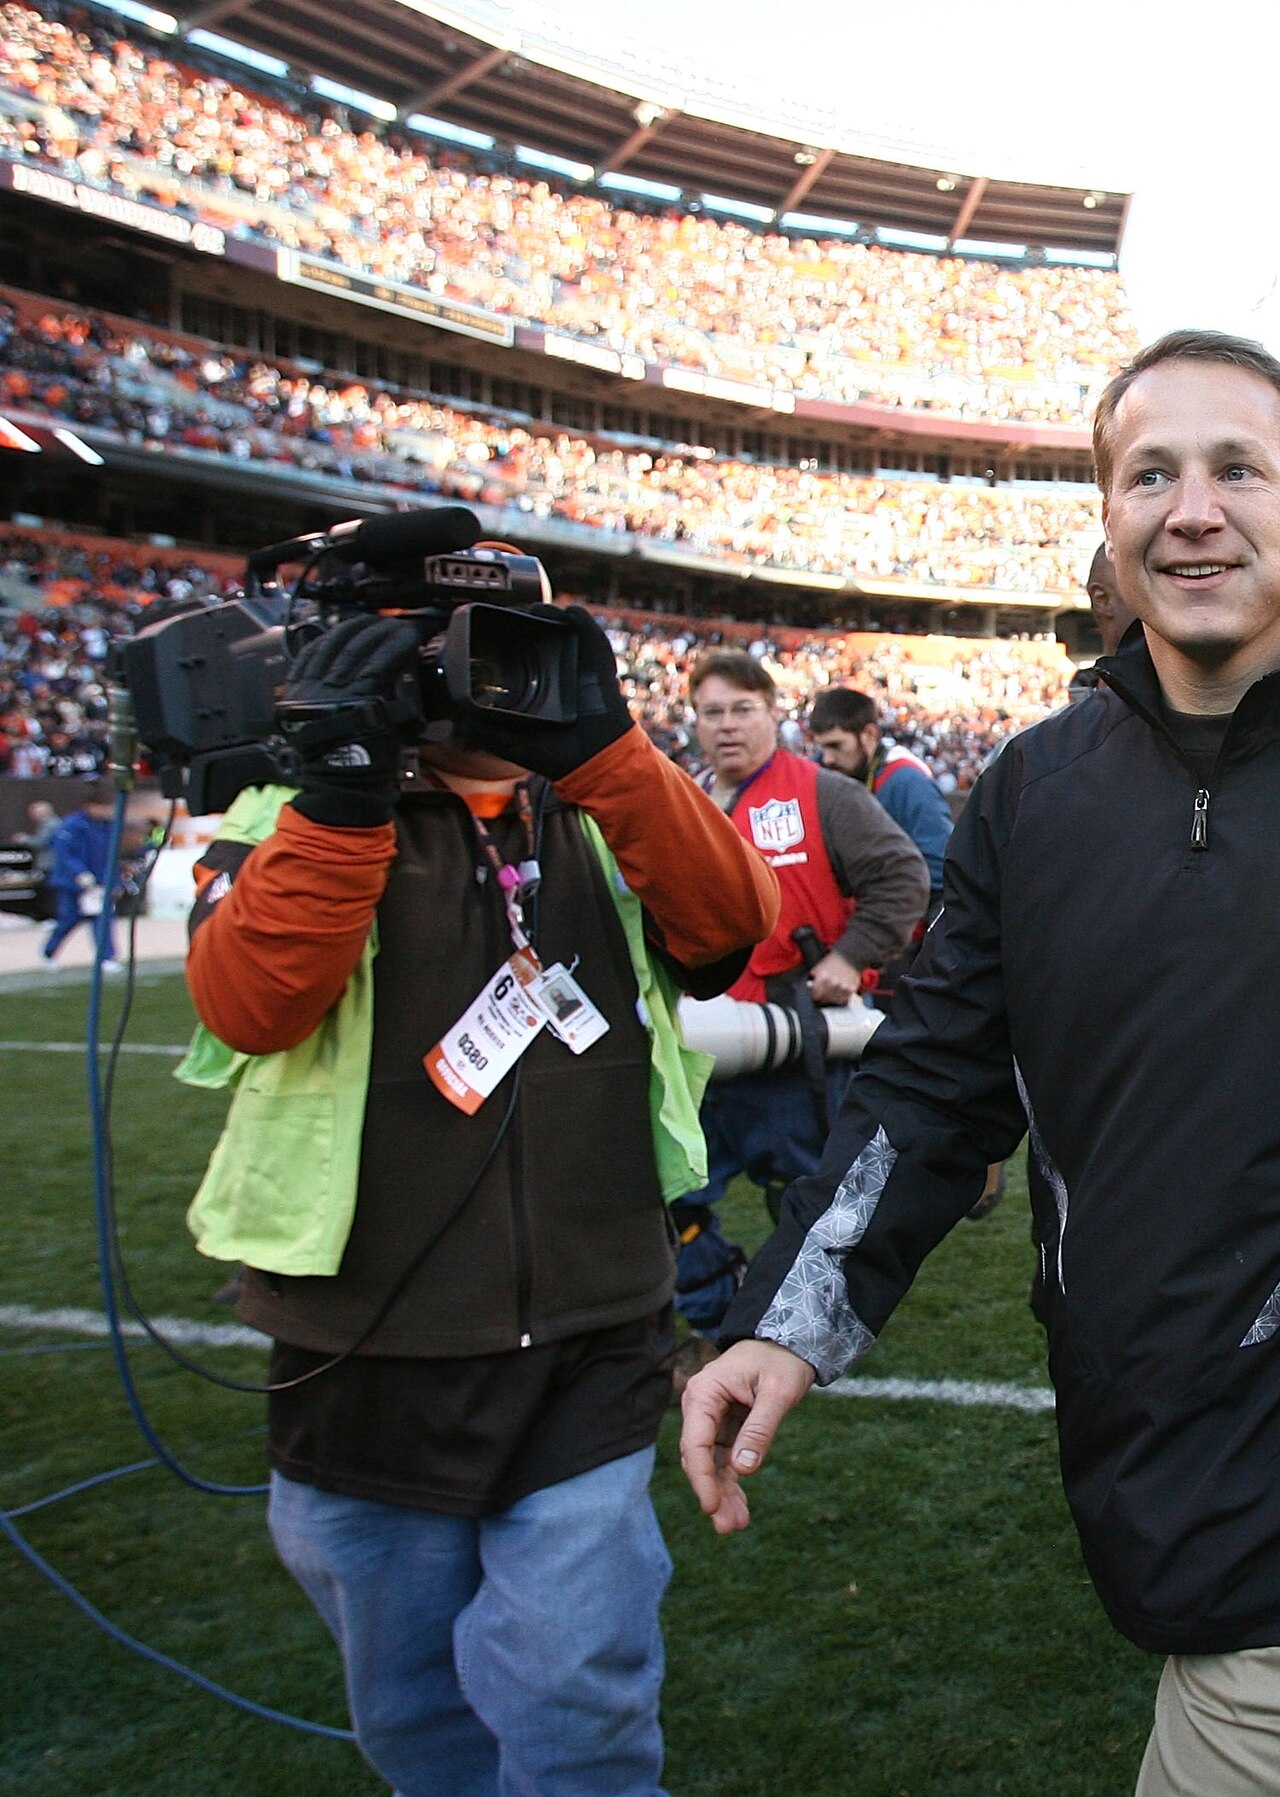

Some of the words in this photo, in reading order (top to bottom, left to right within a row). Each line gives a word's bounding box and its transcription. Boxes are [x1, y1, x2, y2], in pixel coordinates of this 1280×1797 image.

[761, 817, 798, 841] NFL
[494, 975, 514, 1001] 6
[458, 1033, 489, 1071] 0380
